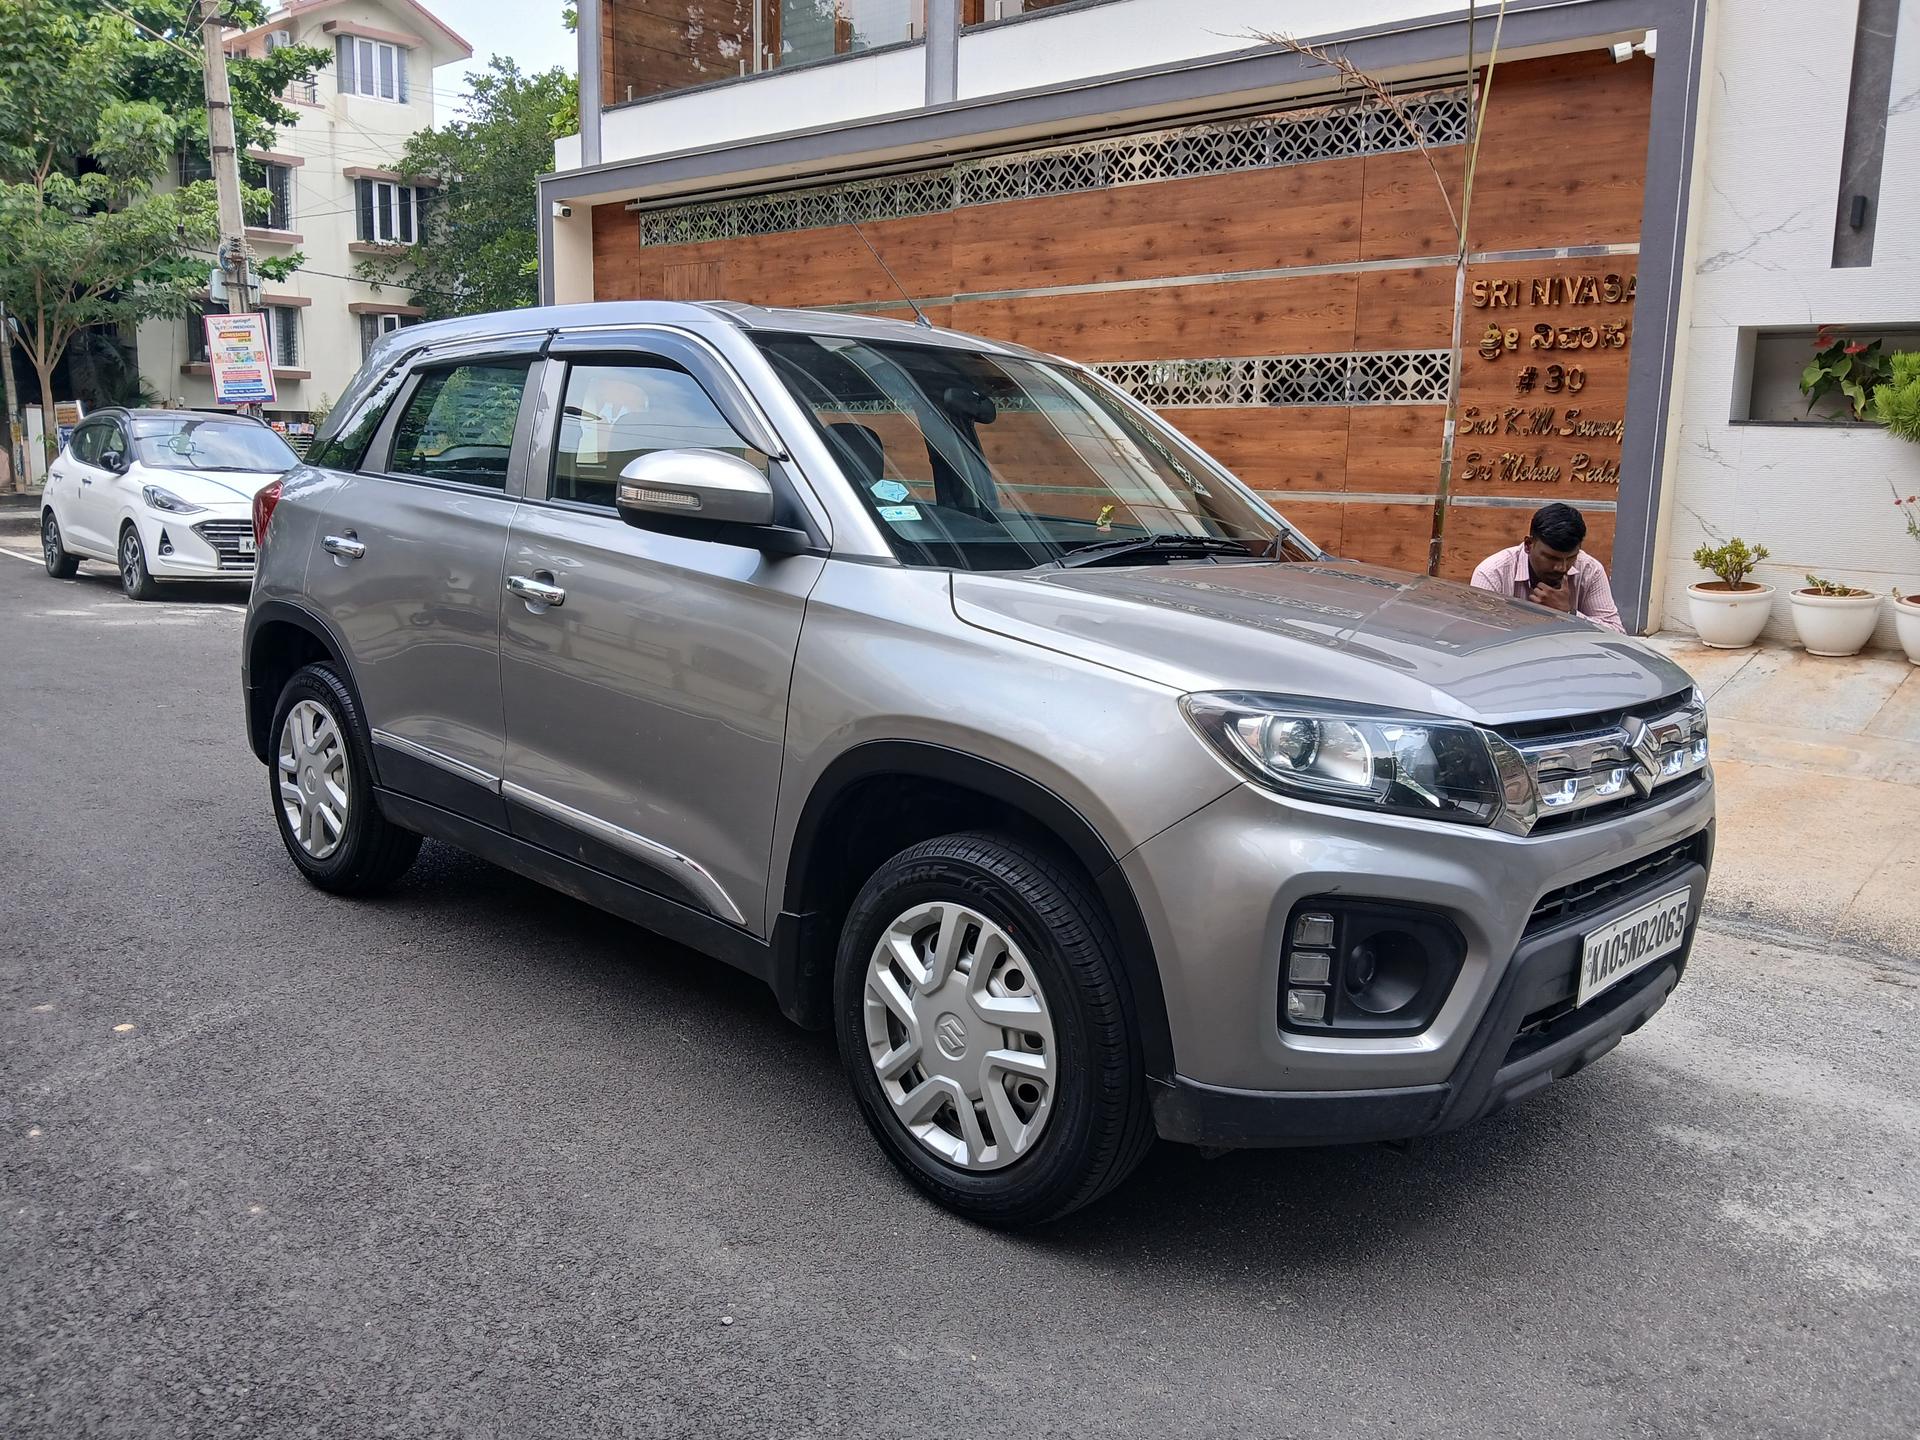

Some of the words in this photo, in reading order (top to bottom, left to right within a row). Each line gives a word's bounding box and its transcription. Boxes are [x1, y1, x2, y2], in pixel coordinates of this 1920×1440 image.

[1471, 278, 1521, 308] SRI
[1529, 273, 1637, 306] NIVASA
[1478, 322, 1520, 360] ಶ್ರೀ
[1461, 450, 1496, 480] Sri
[1589, 901, 1688, 988] KA05NB2065
